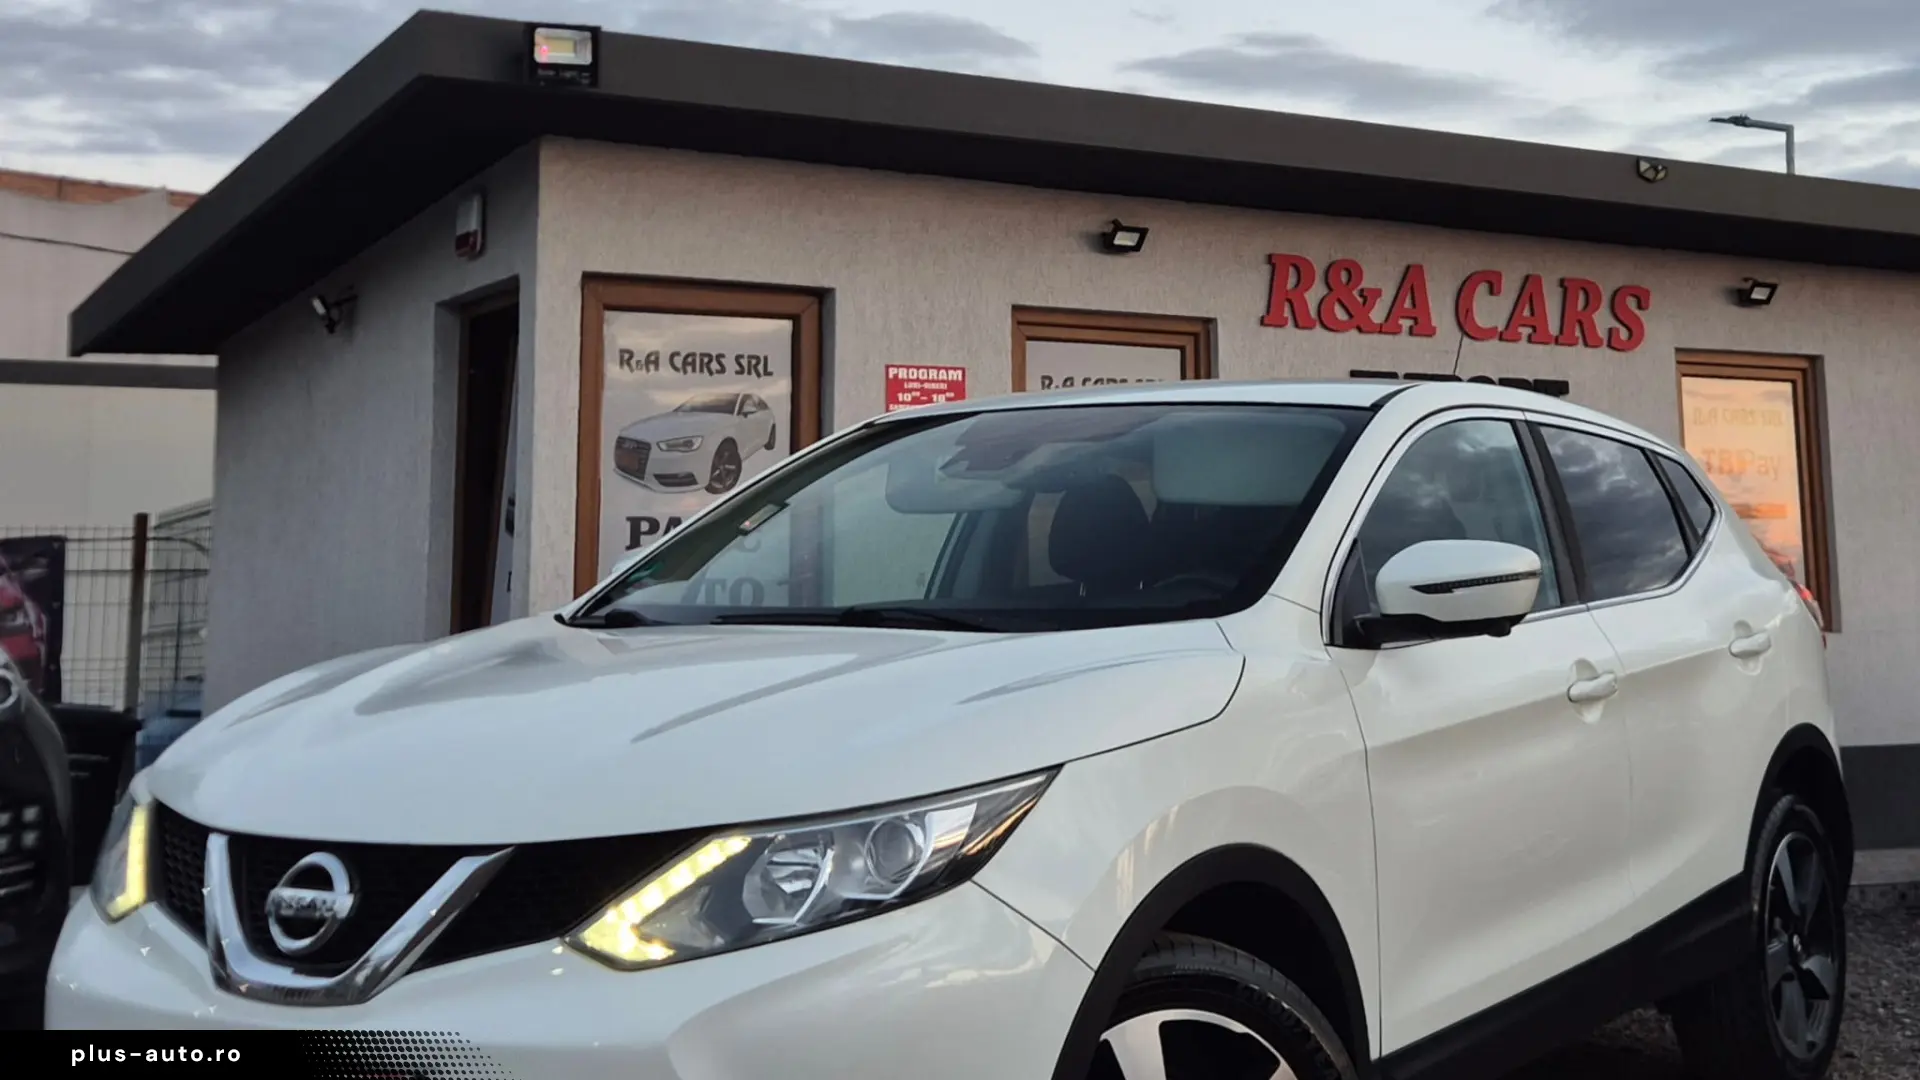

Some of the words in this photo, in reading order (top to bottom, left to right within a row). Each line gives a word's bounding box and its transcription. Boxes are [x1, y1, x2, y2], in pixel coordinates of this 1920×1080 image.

[1260, 253, 1437, 337] R&A
[1456, 269, 1652, 352] CARS
[618, 348, 660, 374] R&A
[668, 350, 727, 377] CARS
[734, 353, 774, 379] SRL
[888, 367, 963, 381] PROGRAM
[1040, 375, 1075, 390] RA
